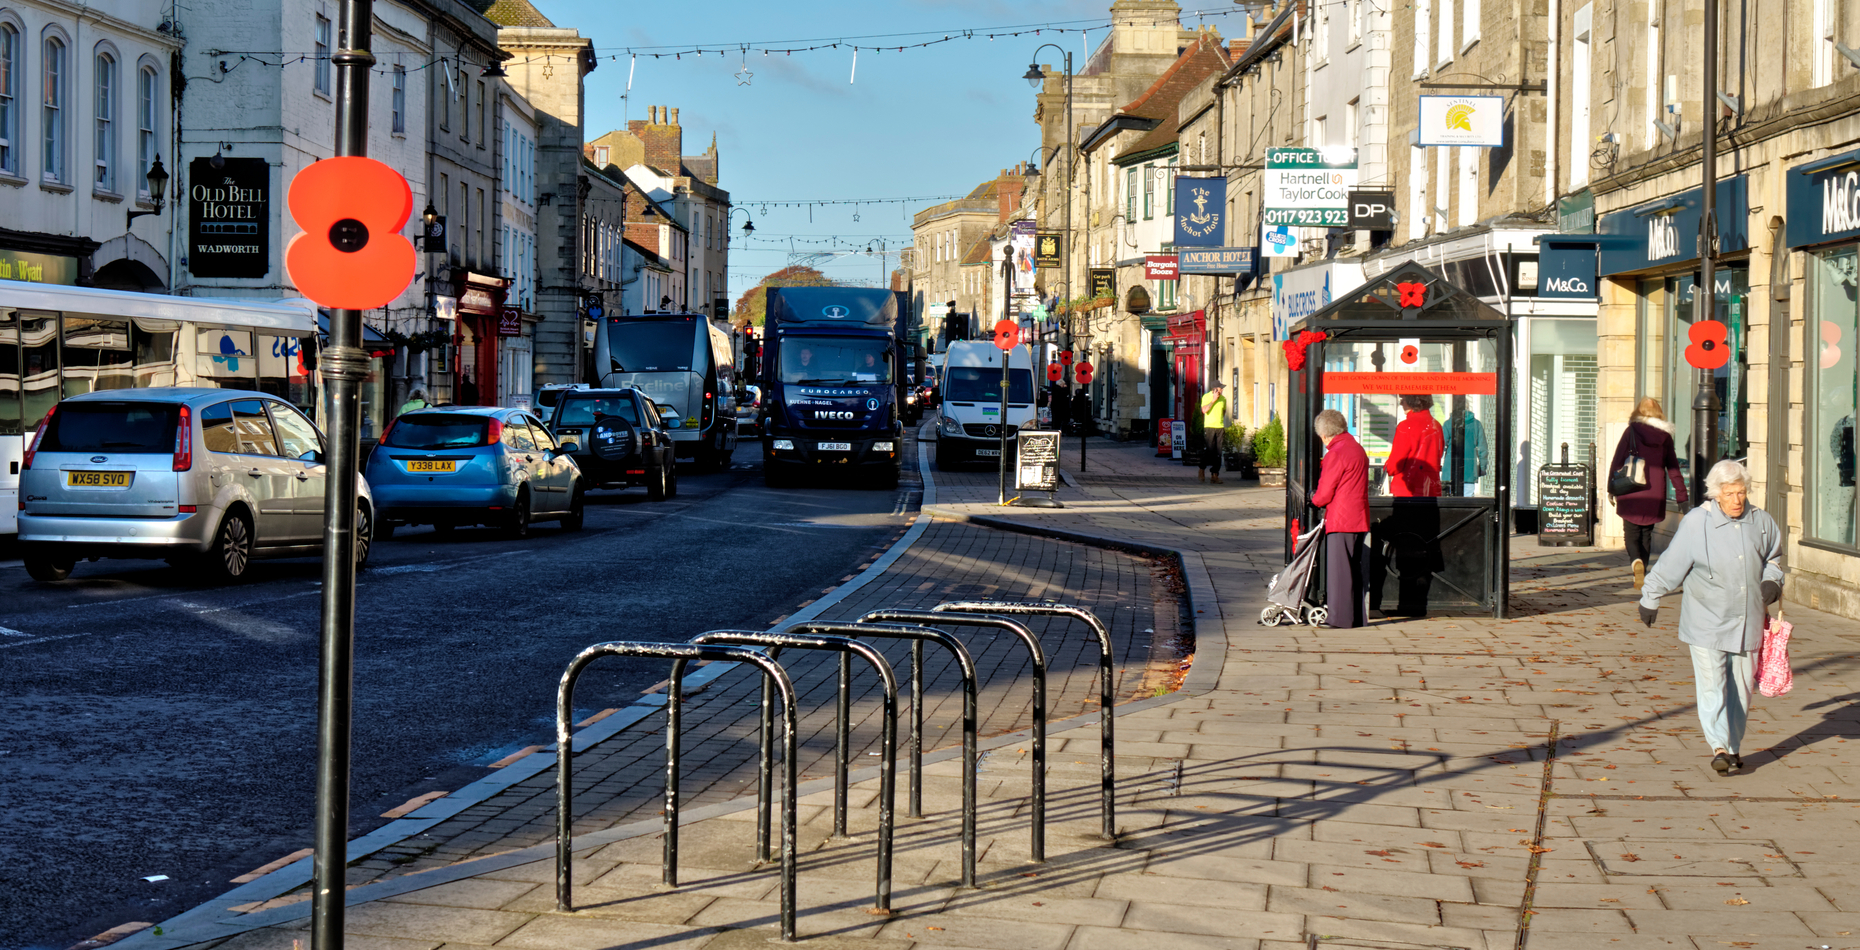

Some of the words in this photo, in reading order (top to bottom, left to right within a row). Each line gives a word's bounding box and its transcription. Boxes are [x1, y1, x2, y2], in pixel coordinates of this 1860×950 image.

[1273, 152, 1314, 163] OFFICE
[223, 176, 235, 185] The
[1280, 172, 1330, 185] Hartnell
[192, 184, 225, 202] OLD
[229, 186, 266, 202] BELL
[1190, 187, 1210, 196] The
[1279, 188, 1316, 202] Taylor
[1317, 188, 1348, 200] Cook
[203, 202, 256, 218] HOTEL
[1355, 204, 1385, 218] DP
[1267, 210, 1296, 223] 0117
[1298, 210, 1322, 224] 923
[1180, 215, 1201, 237] Anchor
[1203, 214, 1219, 235] Hotel
[197, 245, 260, 253] WADWORTH
[1184, 252, 1221, 263] ANCHOR
[1223, 252, 1252, 262] HOTEL
[18, 260, 42, 282] Wyatt
[1147, 261, 1177, 269] Bargain
[1546, 277, 1588, 292] M&Co.
[1288, 292, 1299, 318] BLUE
[1300, 290, 1316, 316] CROSS
[814, 410, 854, 420] IVECO
[72, 474, 100, 484] WX58
[103, 474, 124, 485] SVO
